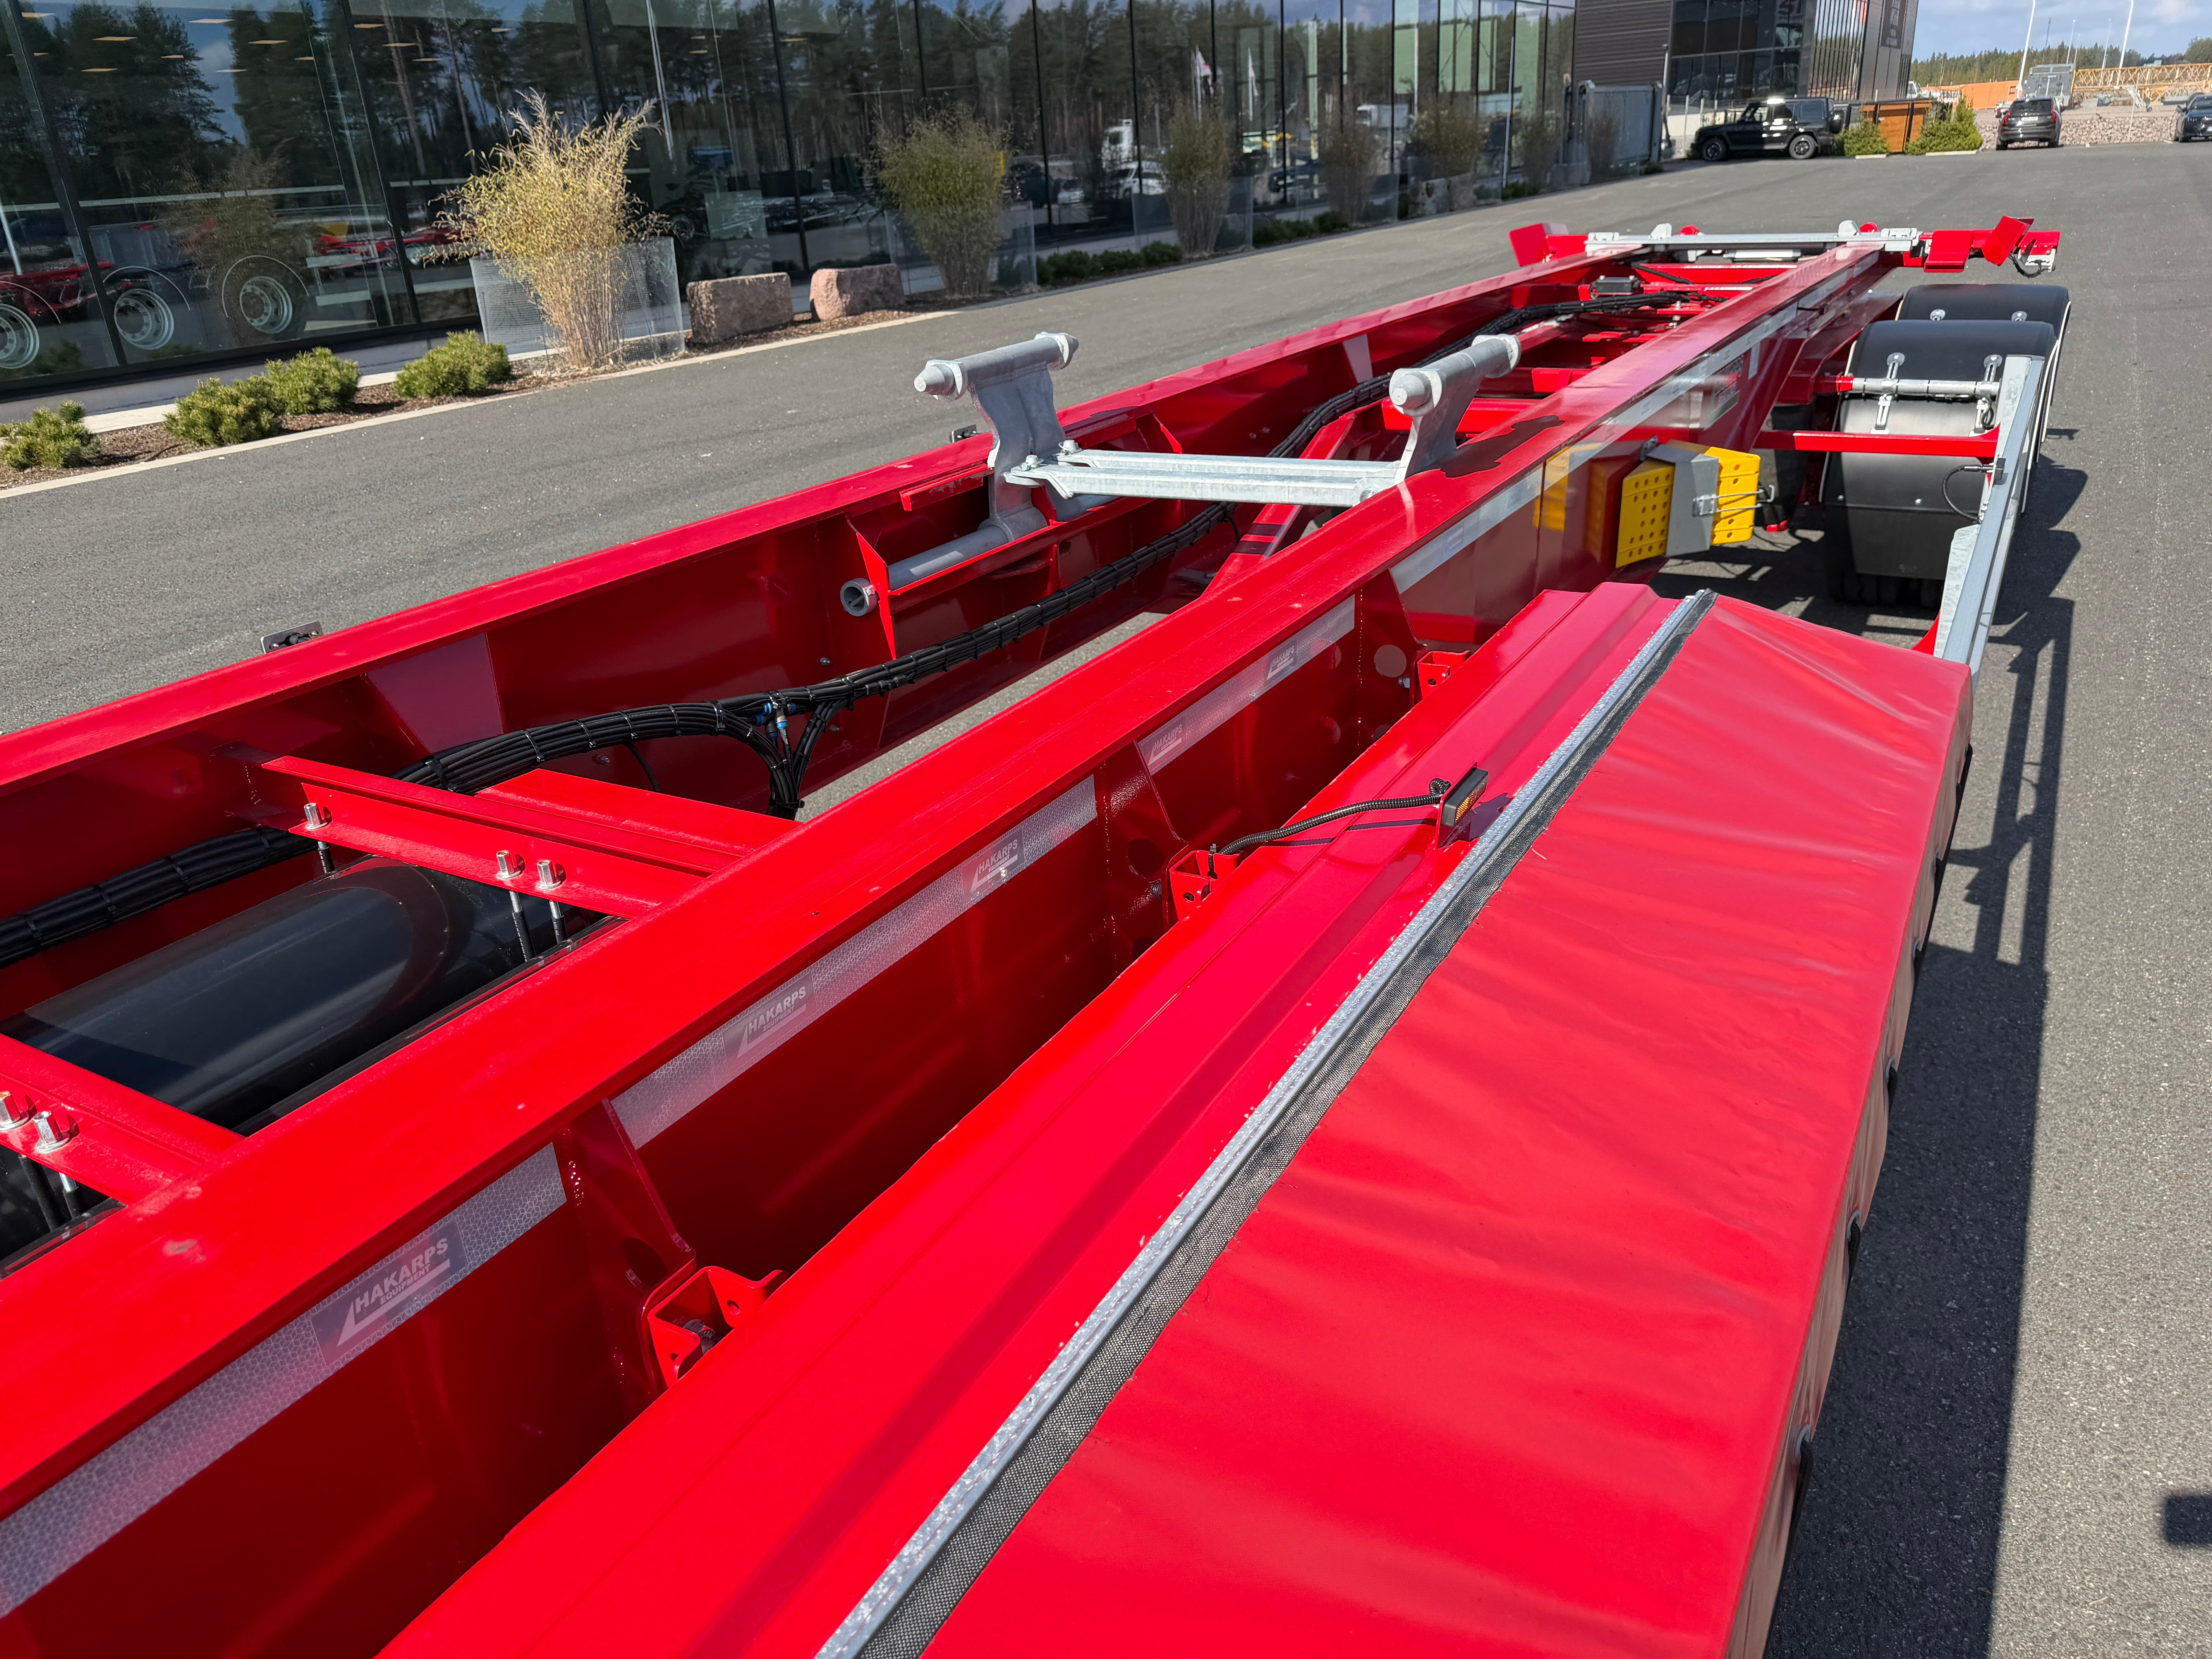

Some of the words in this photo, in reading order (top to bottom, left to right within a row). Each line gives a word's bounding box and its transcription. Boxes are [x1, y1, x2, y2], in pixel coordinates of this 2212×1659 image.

[1154, 724, 1182, 751] HAKARPS
[979, 840, 1017, 874] HAKARPS
[749, 986, 805, 1035] HAKARPS
[764, 1006, 794, 1031] EQUIPMENT
[355, 1238, 448, 1313] HAKARPS
[381, 1264, 430, 1304] EQUIPMENT
